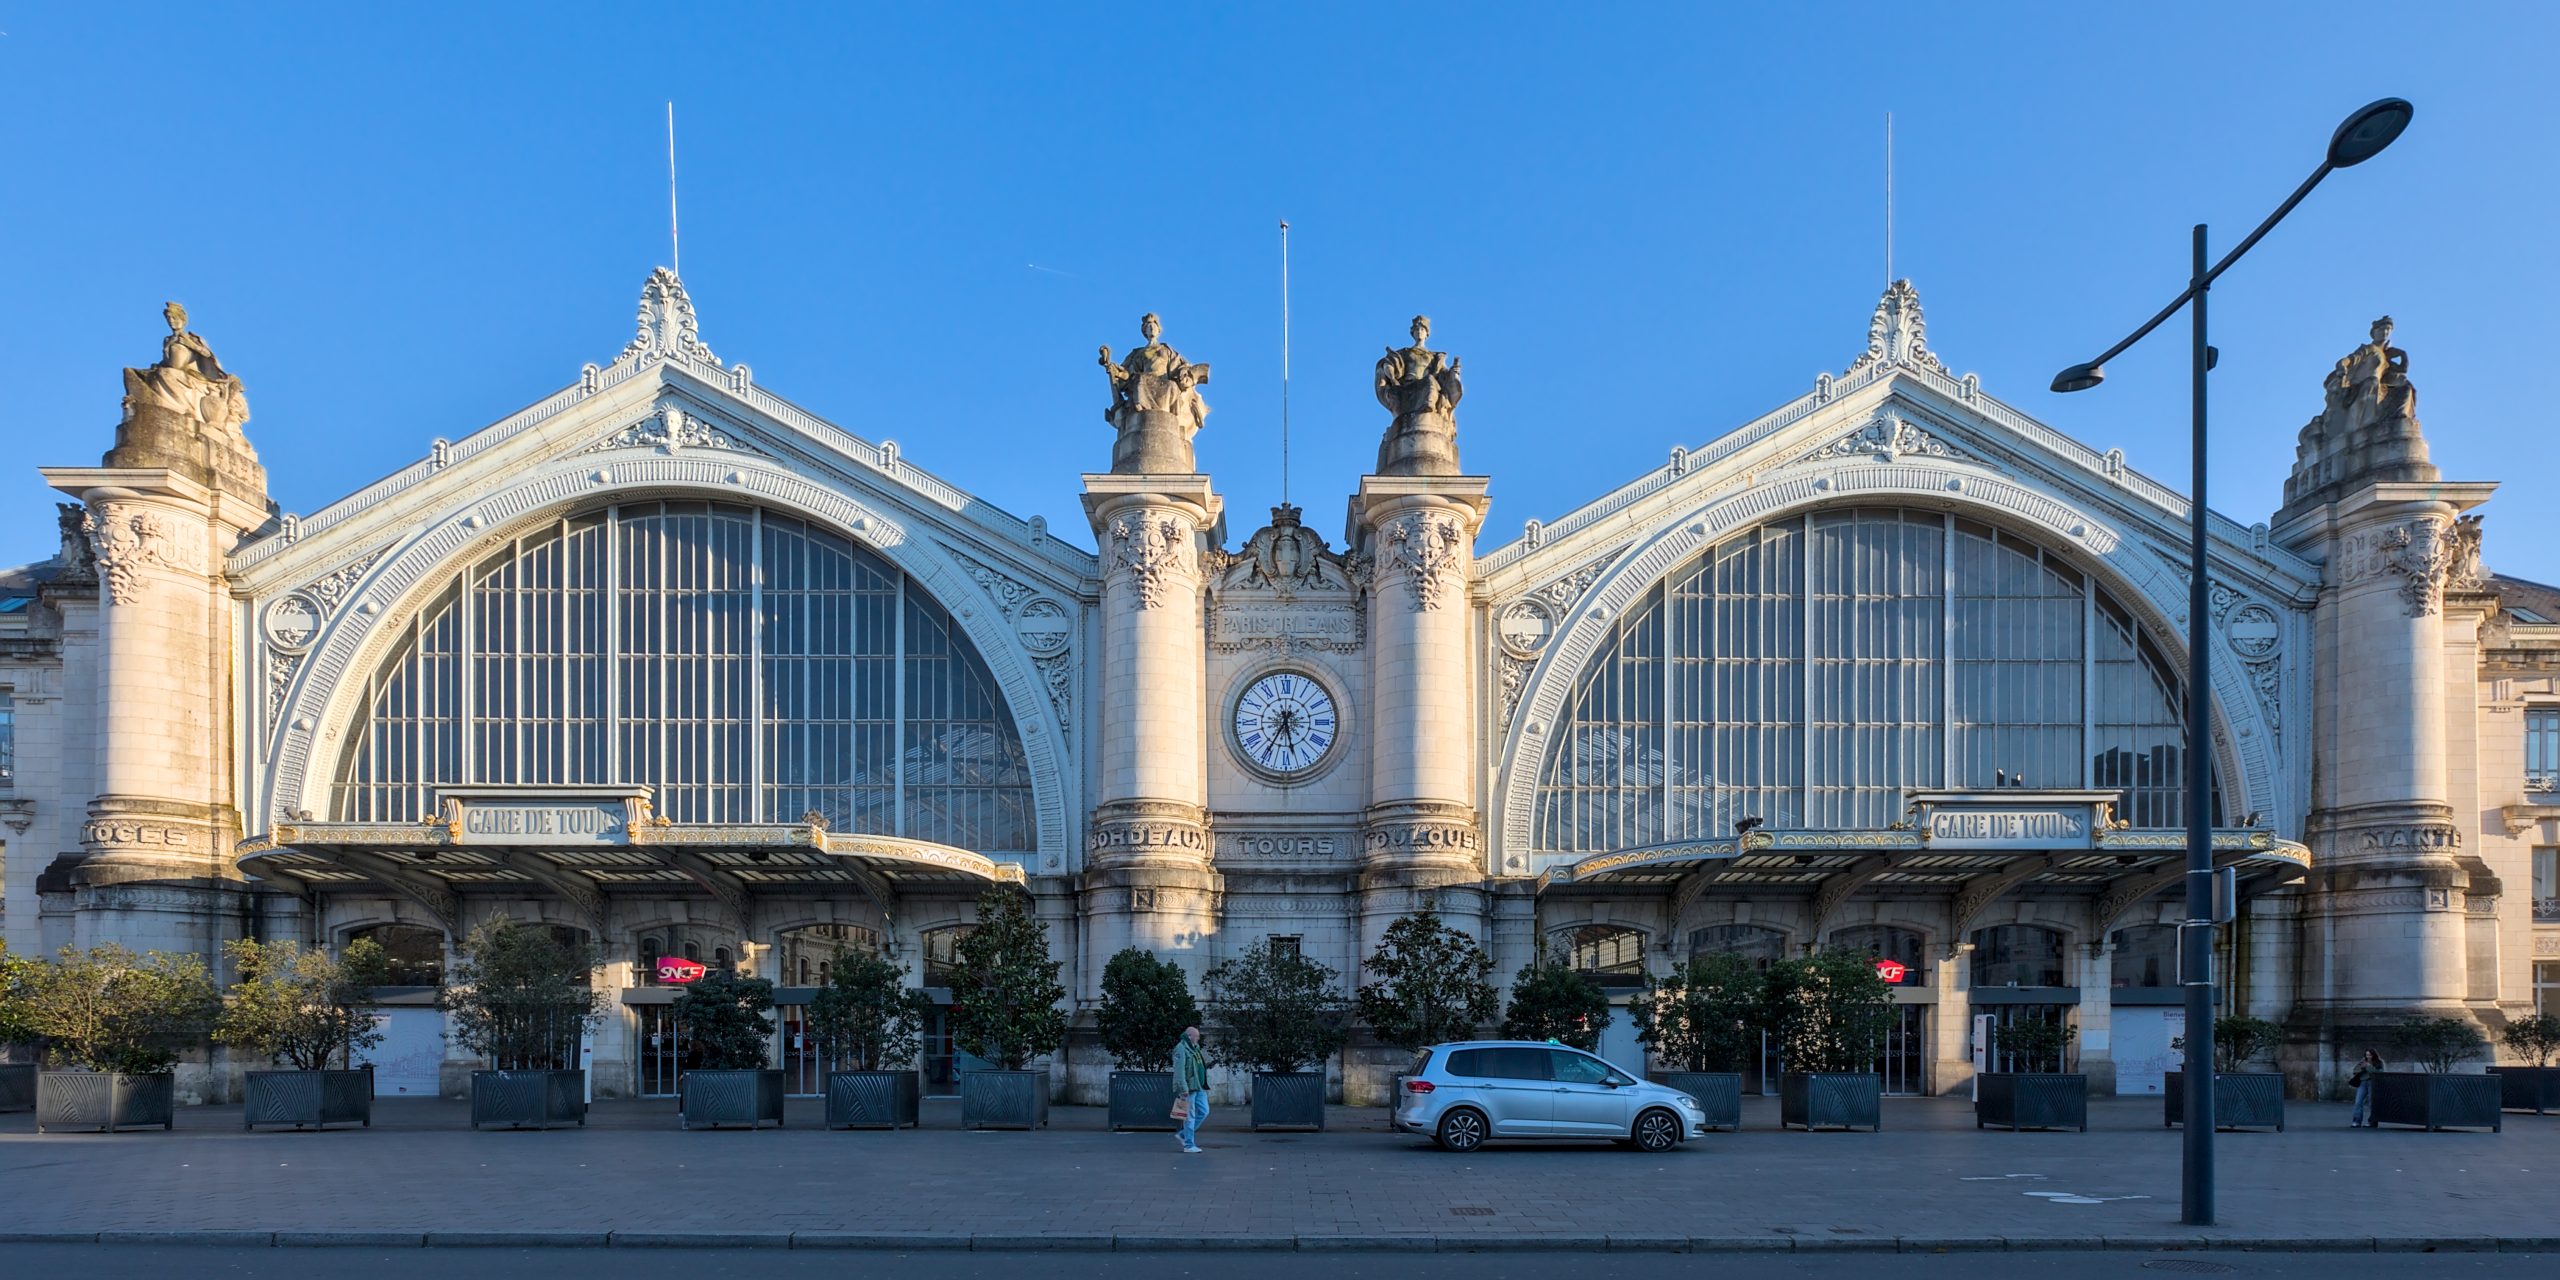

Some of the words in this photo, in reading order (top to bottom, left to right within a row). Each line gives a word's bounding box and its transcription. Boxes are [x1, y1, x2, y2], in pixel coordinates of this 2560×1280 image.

[1221, 615, 1351, 634] PARIS-ORLEANS
[467, 808, 521, 835] GARE
[525, 808, 553, 835] DE
[556, 808, 624, 835] TOURS
[1934, 813, 1986, 839] GARE
[1989, 813, 2017, 839] DE
[2019, 813, 2083, 839] TOURS
[1238, 837, 1334, 855] TOURS
[659, 966, 702, 979] SNCF
[1875, 966, 1904, 979] NCF
